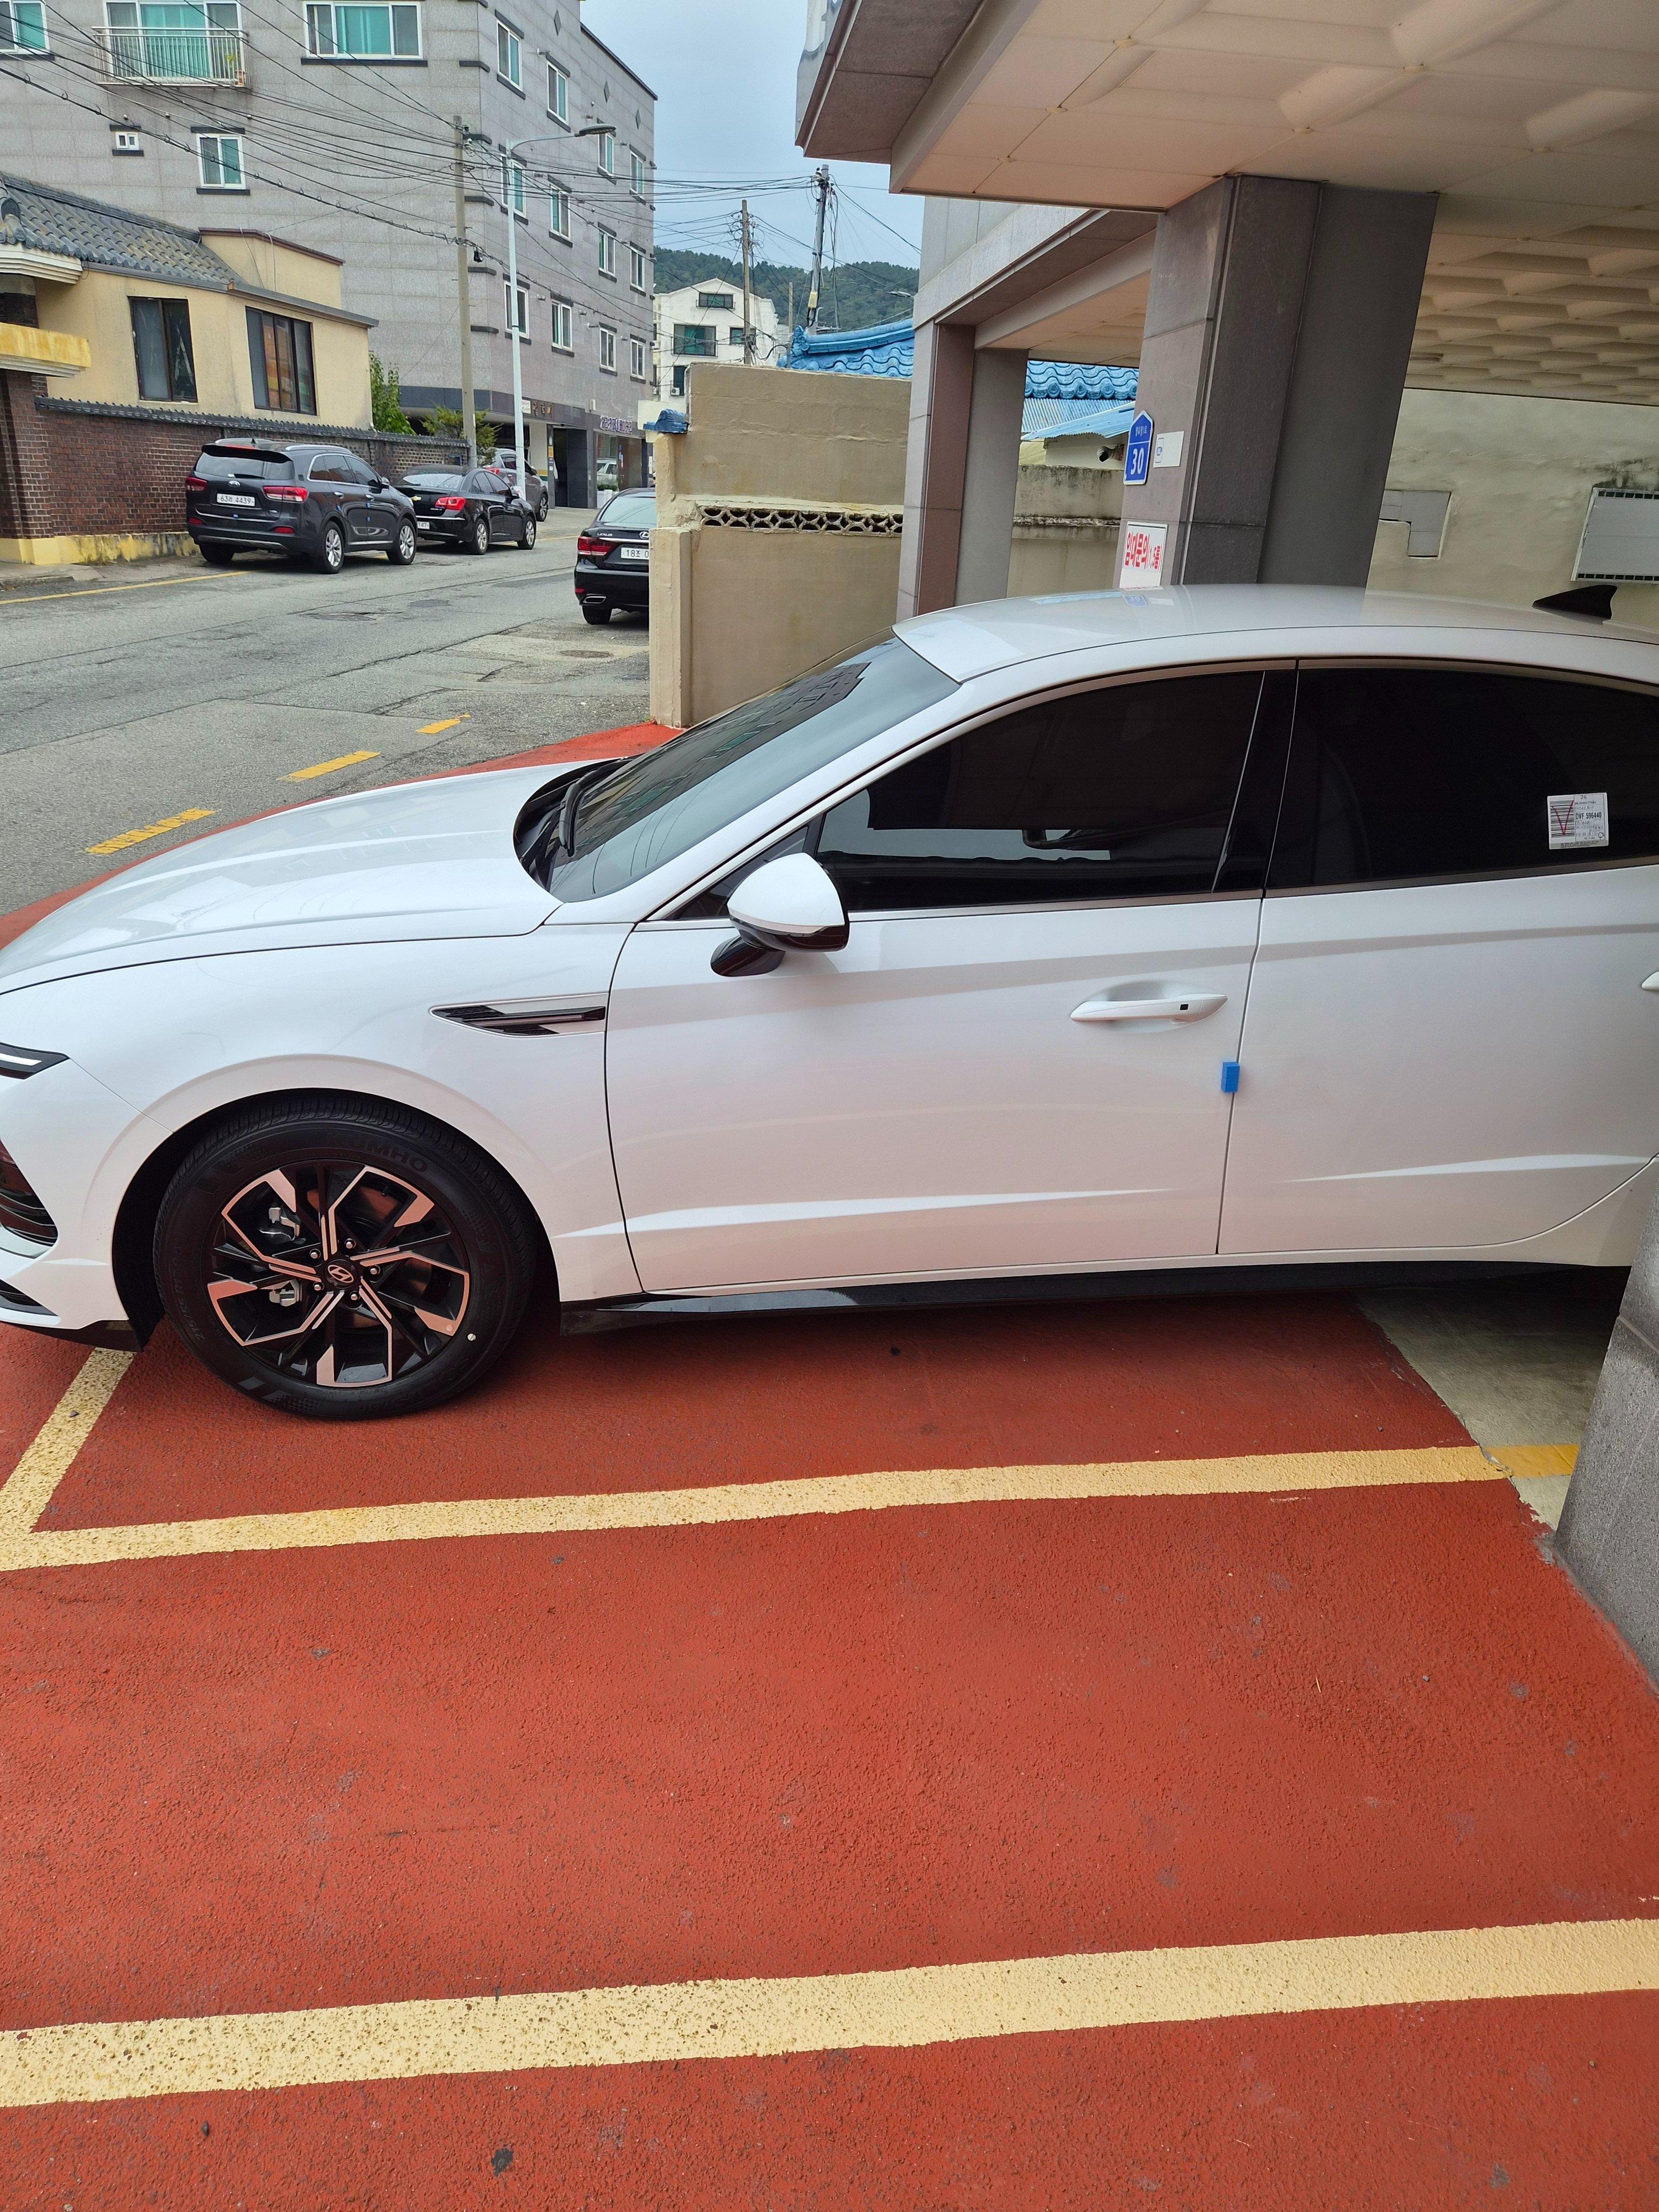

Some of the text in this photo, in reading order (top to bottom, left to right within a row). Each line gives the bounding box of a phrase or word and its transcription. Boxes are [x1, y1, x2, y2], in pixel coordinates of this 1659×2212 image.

[1130, 447, 1144, 475] 30
[626, 549, 641, 557] 18조
[327, 1132, 429, 1173] KUMHO
